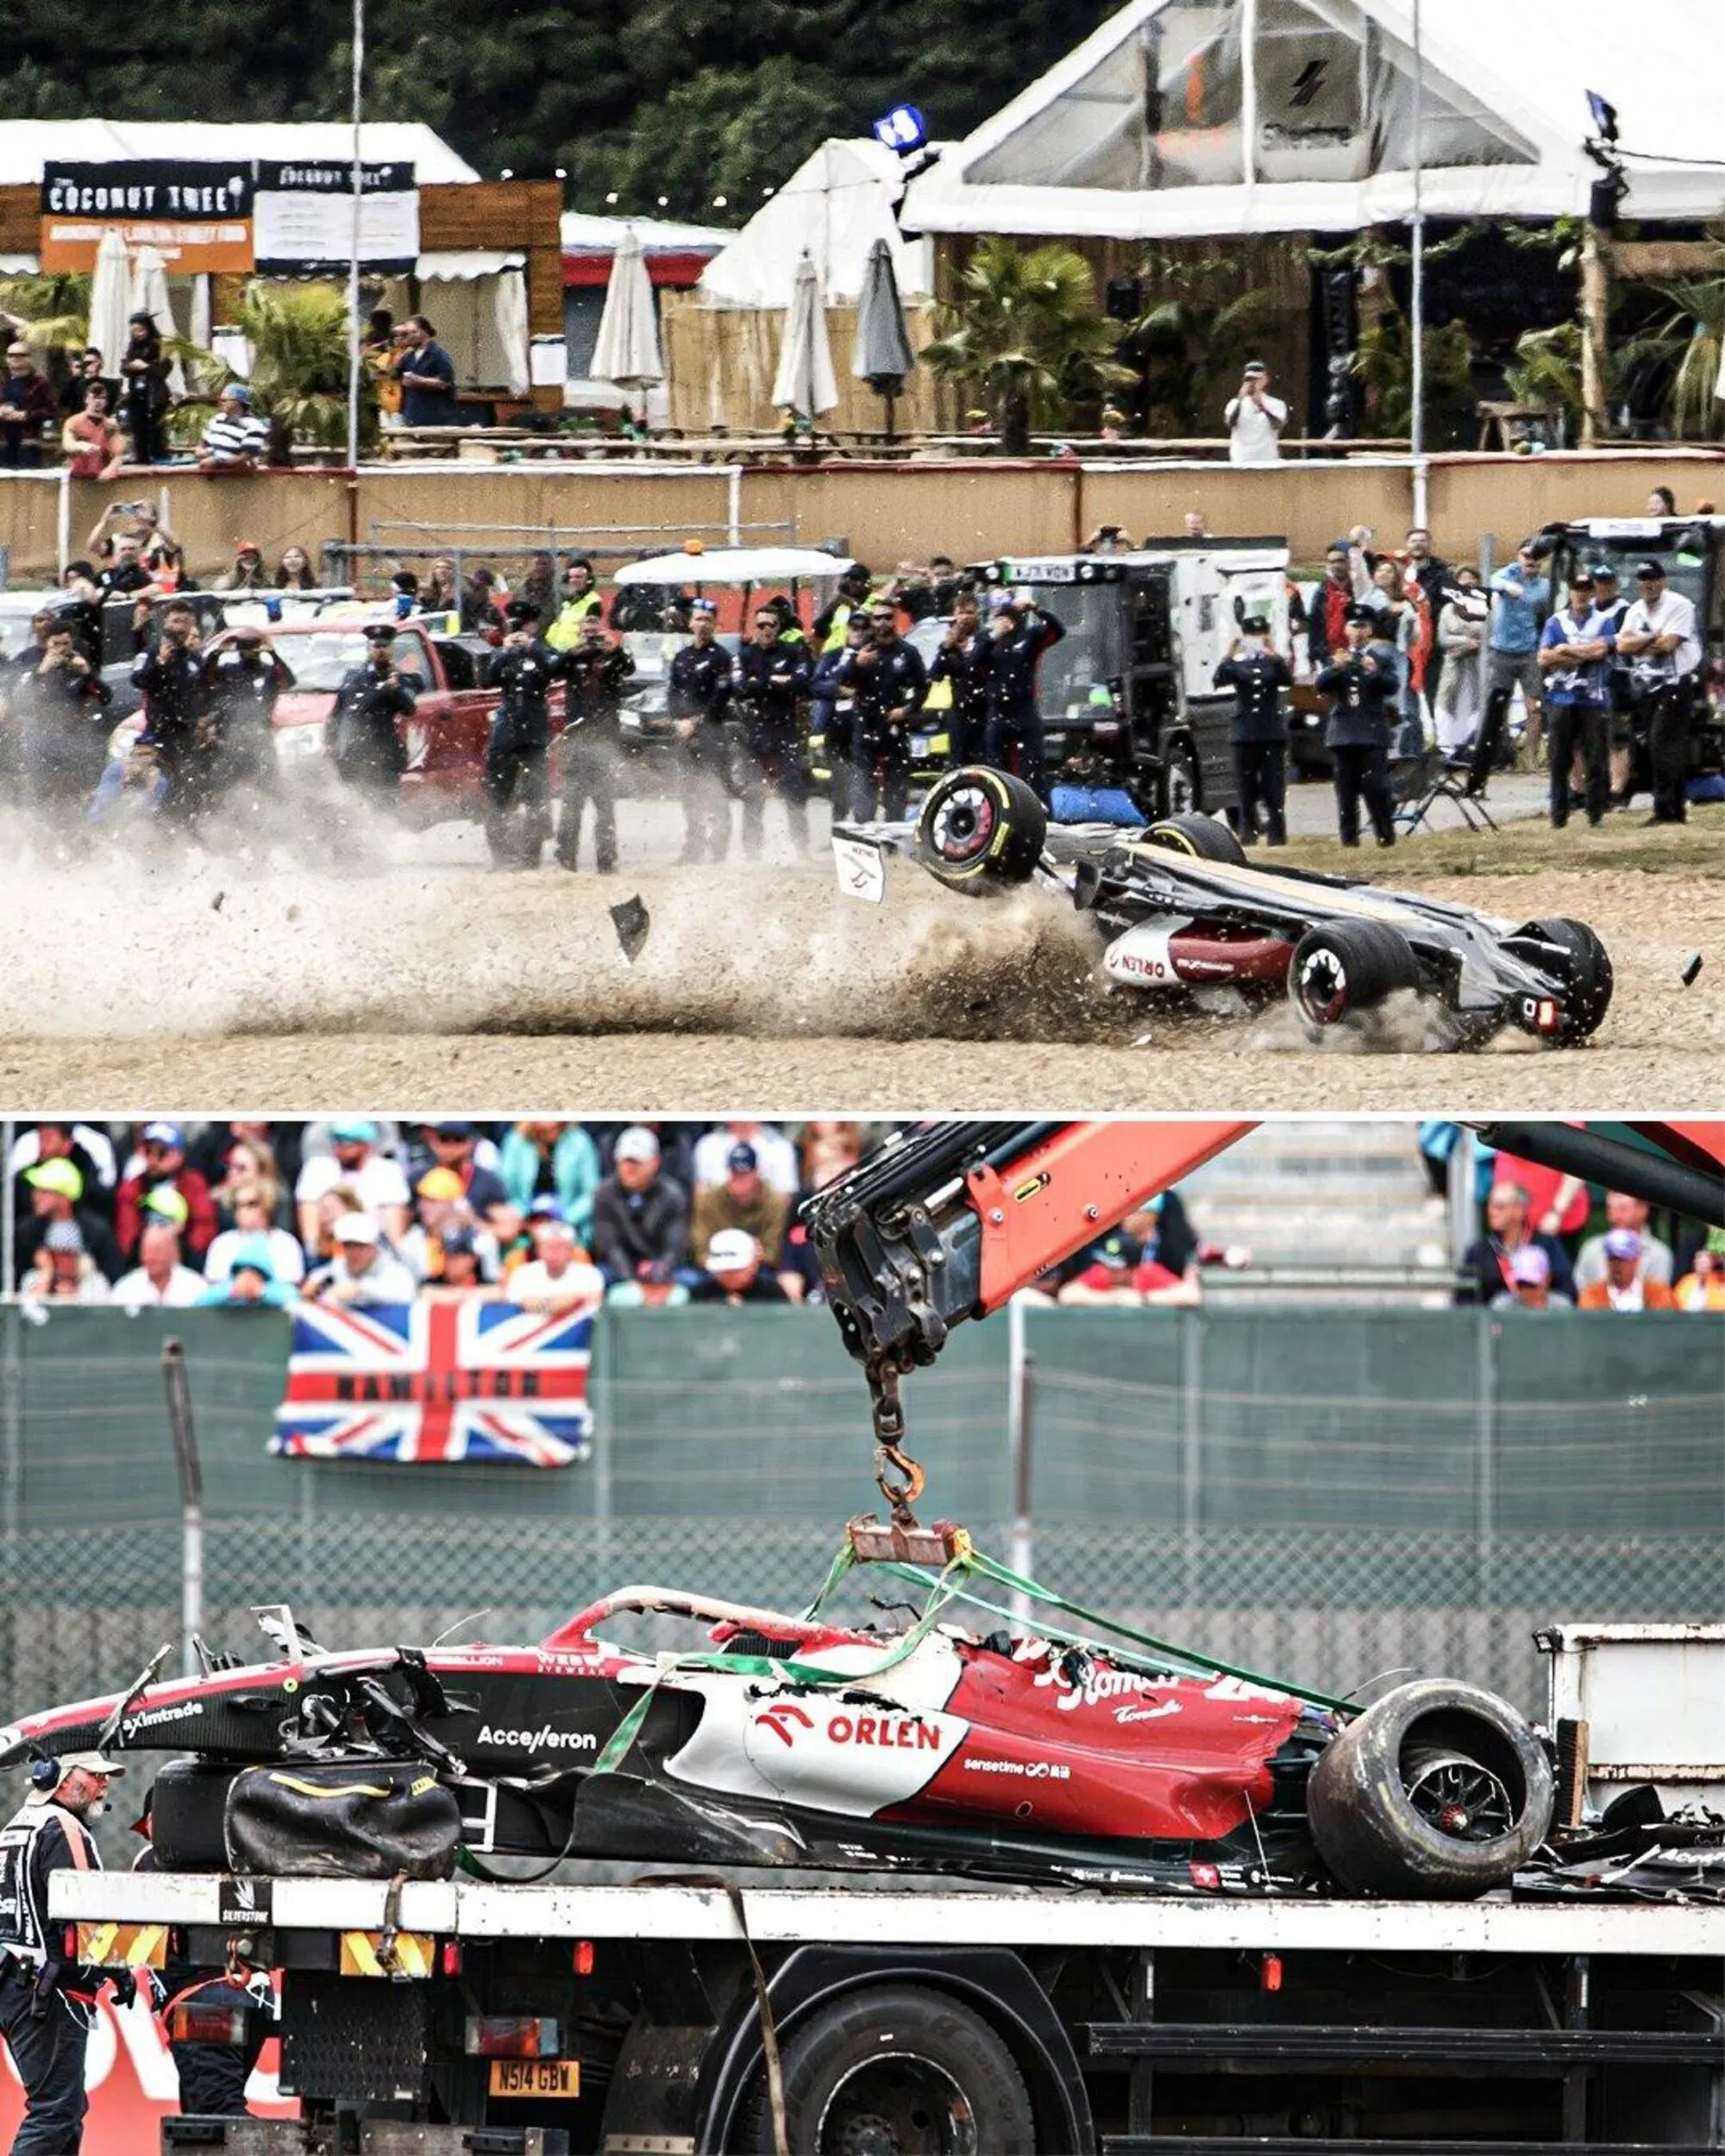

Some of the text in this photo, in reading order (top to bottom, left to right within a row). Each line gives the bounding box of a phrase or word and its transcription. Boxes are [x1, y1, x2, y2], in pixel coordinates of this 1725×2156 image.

[49, 186, 228, 212] COCONUT TREE
[1122, 954, 1165, 978] ORLEN
[337, 1369, 540, 1401] HAMILTON
[827, 1715, 940, 1750] ORLEN
[964, 1758, 1025, 1775] sensetime
[499, 2062, 569, 2091] N514 GBW
